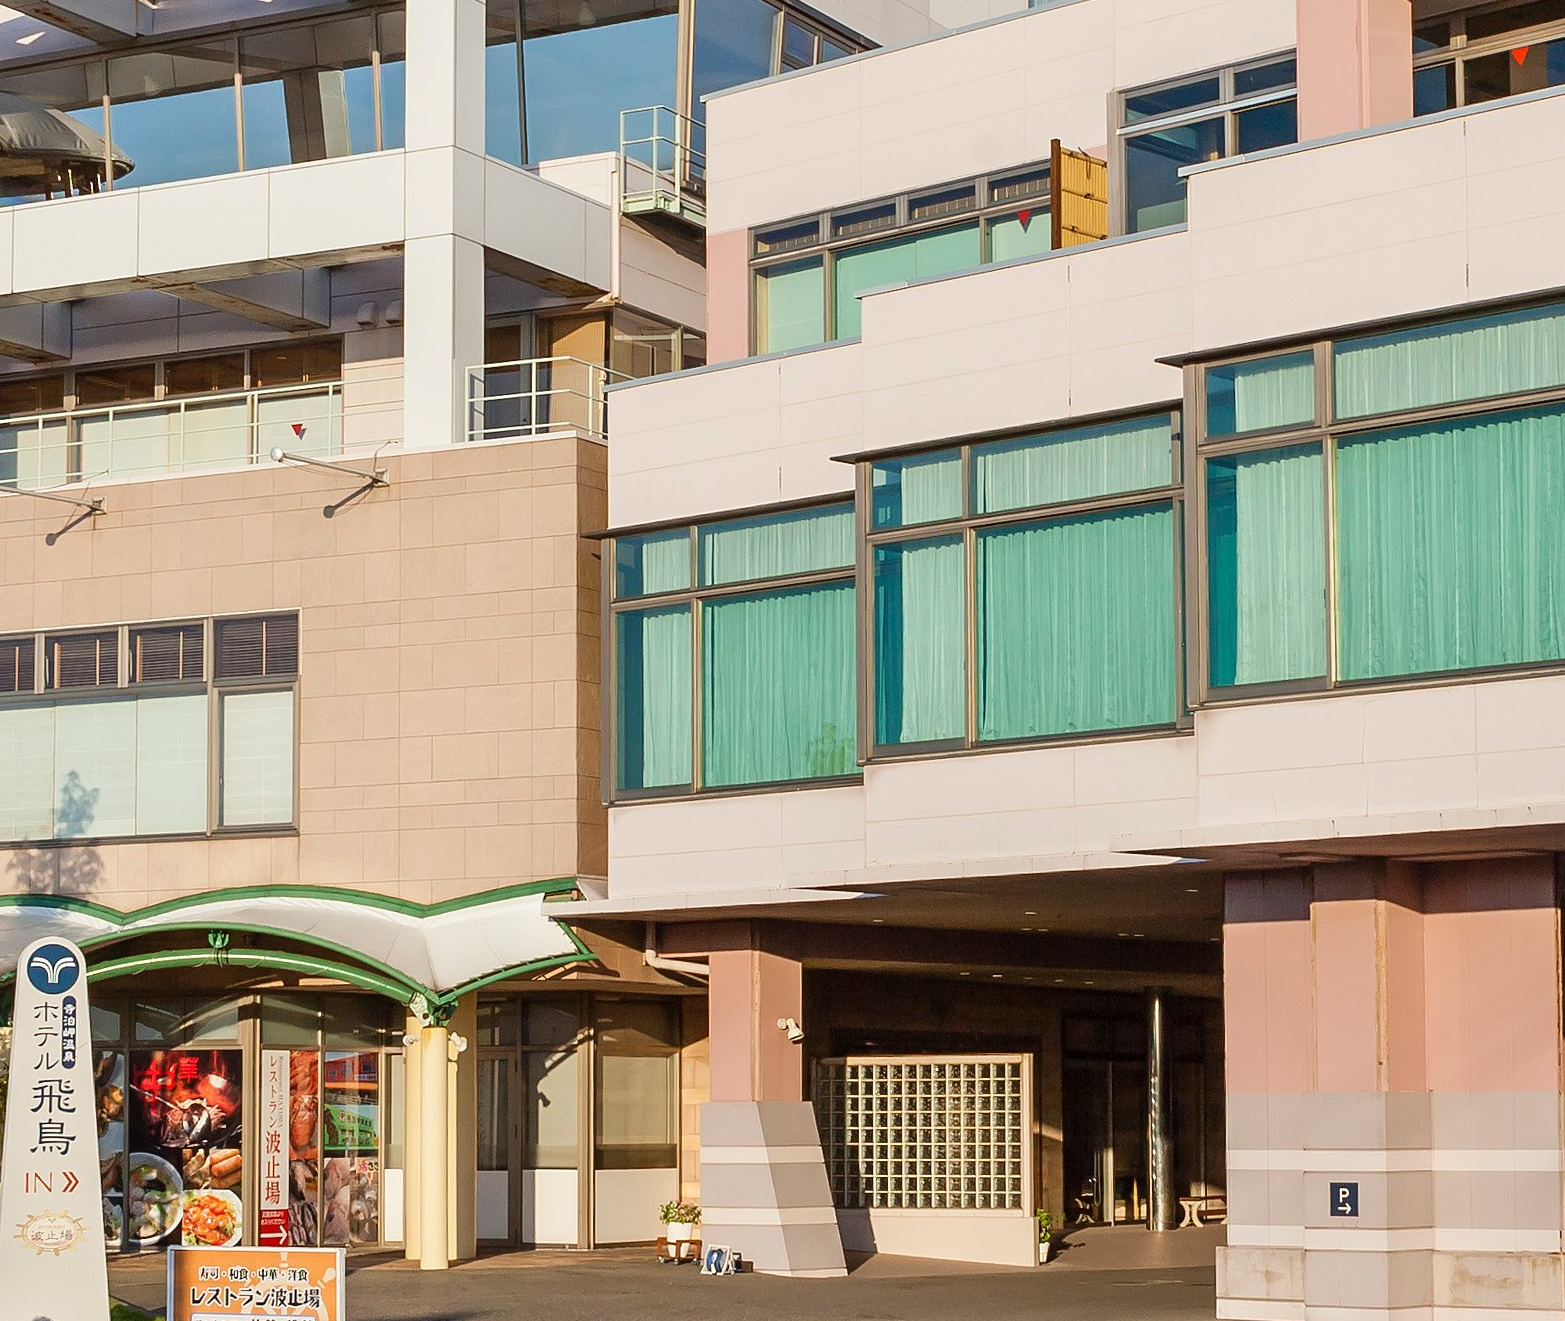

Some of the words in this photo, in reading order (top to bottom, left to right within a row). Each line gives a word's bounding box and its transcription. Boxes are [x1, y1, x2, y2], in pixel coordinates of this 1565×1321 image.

[30, 1001, 76, 1155] ホテル飛鳥
[265, 1055, 281, 1205] レストラン波止場
[25, 1172, 52, 1193] IN
[1339, 1187, 1350, 1203] P
[191, 1287, 321, 1309] レストラン波止場
